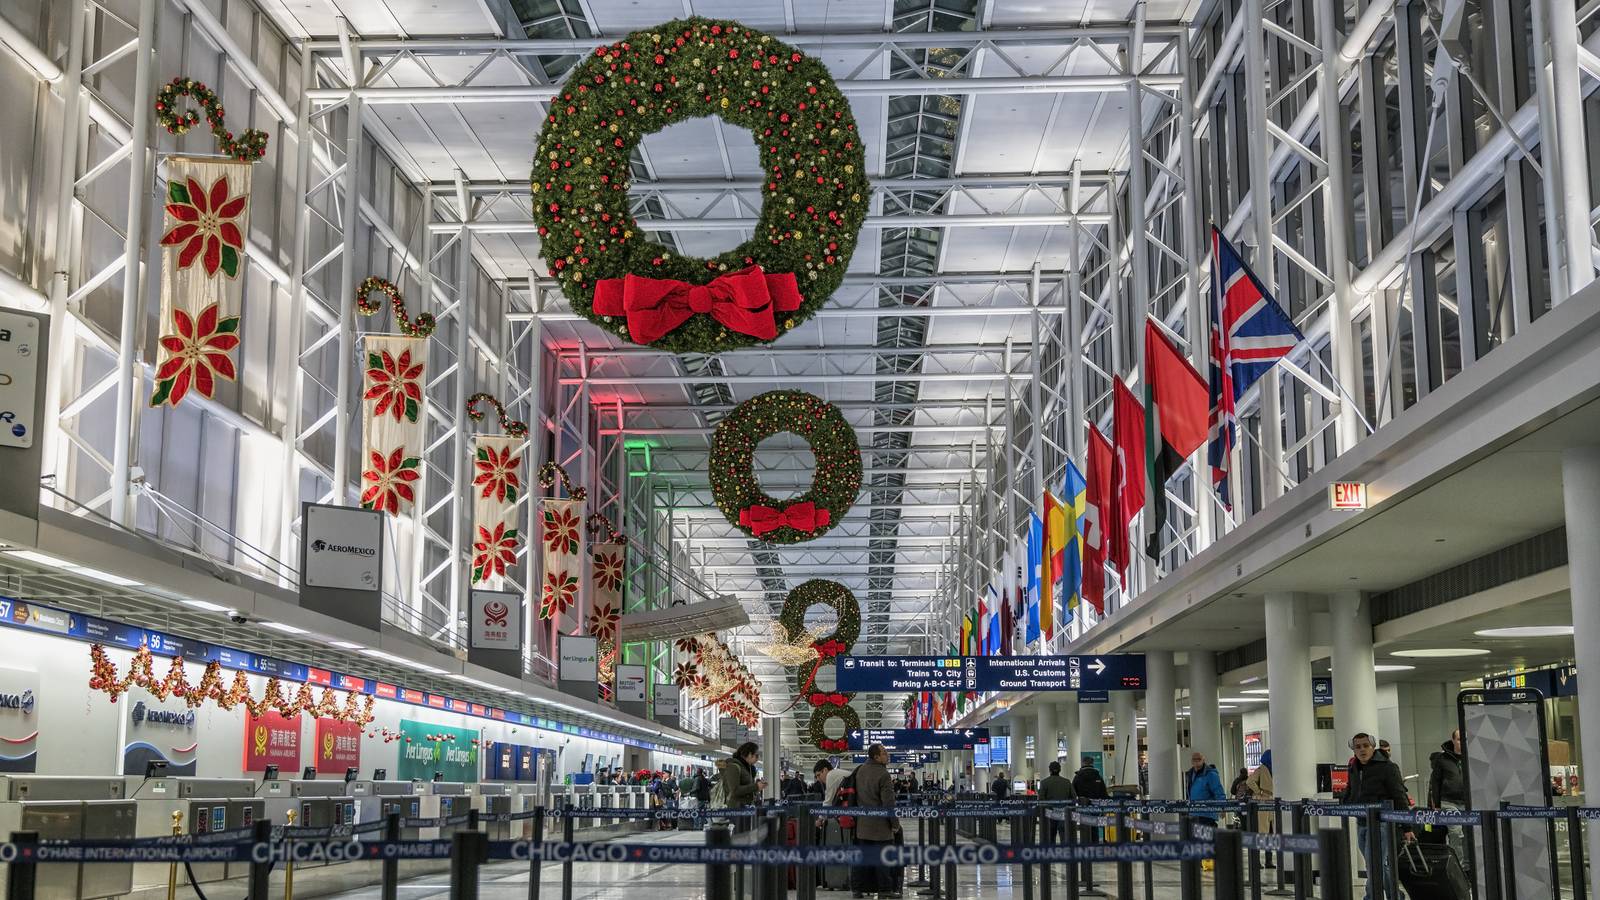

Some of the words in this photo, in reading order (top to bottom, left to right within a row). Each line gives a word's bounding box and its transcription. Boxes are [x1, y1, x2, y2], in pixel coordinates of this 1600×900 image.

[1335, 483, 1361, 502] EXIT
[151, 635, 161, 649] 56
[260, 658, 267, 671] 55
[946, 670, 962, 678] City
[271, 729, 296, 747] 海南航空
[406, 743, 416, 759] Aer
[416, 744, 433, 765] Lingus
[894, 810, 939, 818] CHICAGO
[37, 847, 82, 859] O'HARE
[85, 846, 179, 859] INTERNATIONAL
[183, 847, 236, 859] AIRPORT
[252, 842, 364, 862] CHICAGO
[384, 844, 432, 856] O'HARE
[511, 842, 627, 861] CHICAGO
[649, 847, 698, 860] O'HARE
[700, 848, 804, 862] INTERNATIONAL
[805, 849, 861, 862] AIRPORT
[881, 844, 999, 866] CHICAGO
[1021, 848, 1072, 860] O'HARE
[1074, 844, 1178, 858] INTERNATIONAL
